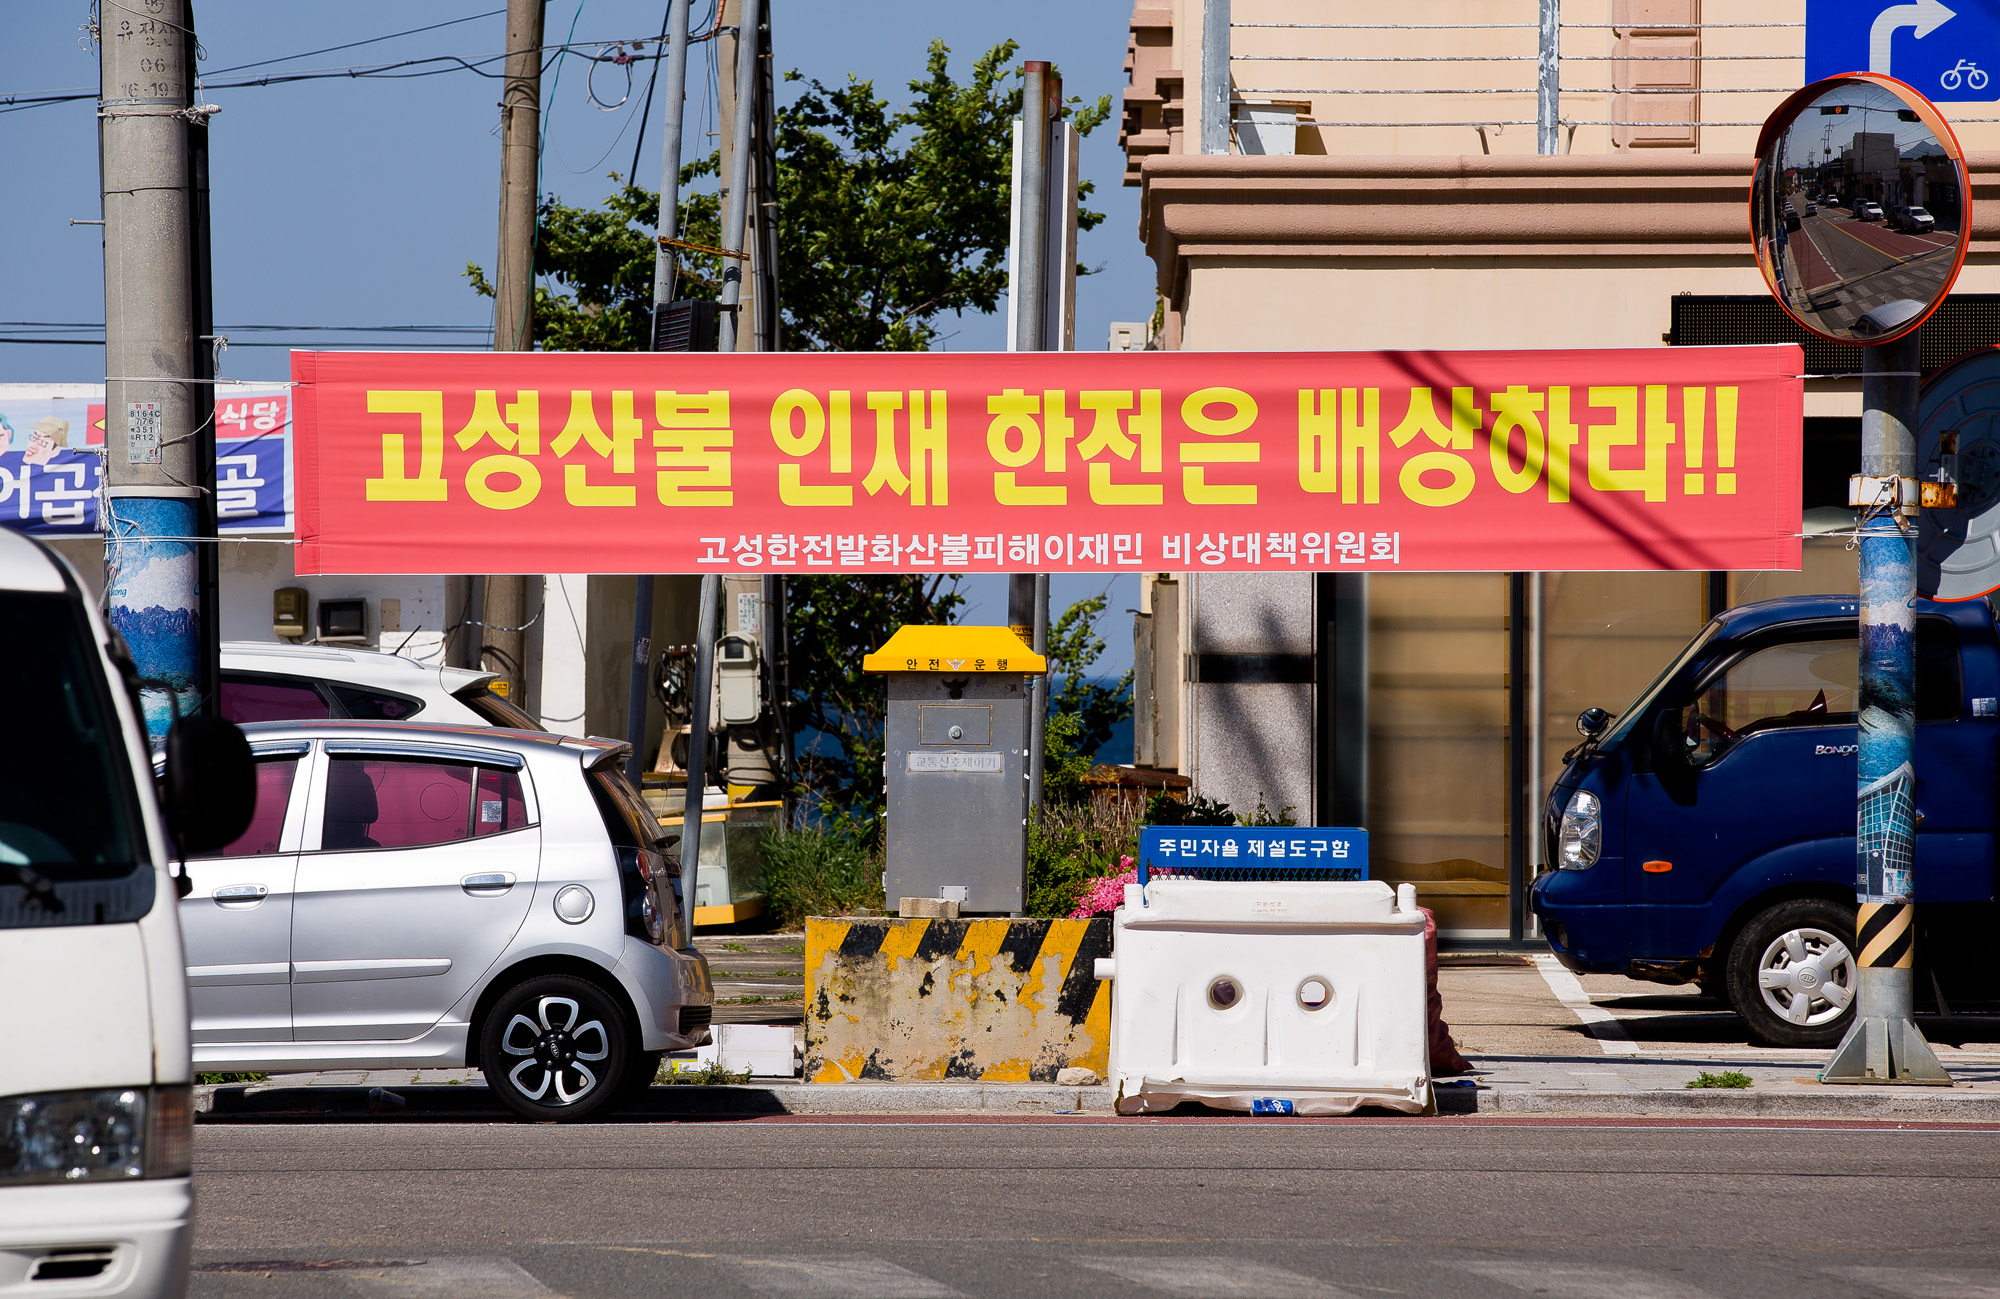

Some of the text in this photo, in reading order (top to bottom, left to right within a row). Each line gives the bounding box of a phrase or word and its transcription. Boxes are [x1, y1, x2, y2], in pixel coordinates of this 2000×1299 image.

[130, 410, 161, 418] 8164C
[221, 401, 280, 431] 식당
[366, 385, 1739, 510] 고성산불 인재 한전은 배상하라!!
[697, 532, 1400, 566] 고성한전발화산불피해이재민 비상대책위원회
[906, 658, 1008, 671] 안전 운행
[915, 756, 996, 769] 교통신호제어기
[1159, 839, 1350, 858] 주민자율 제설도구함
